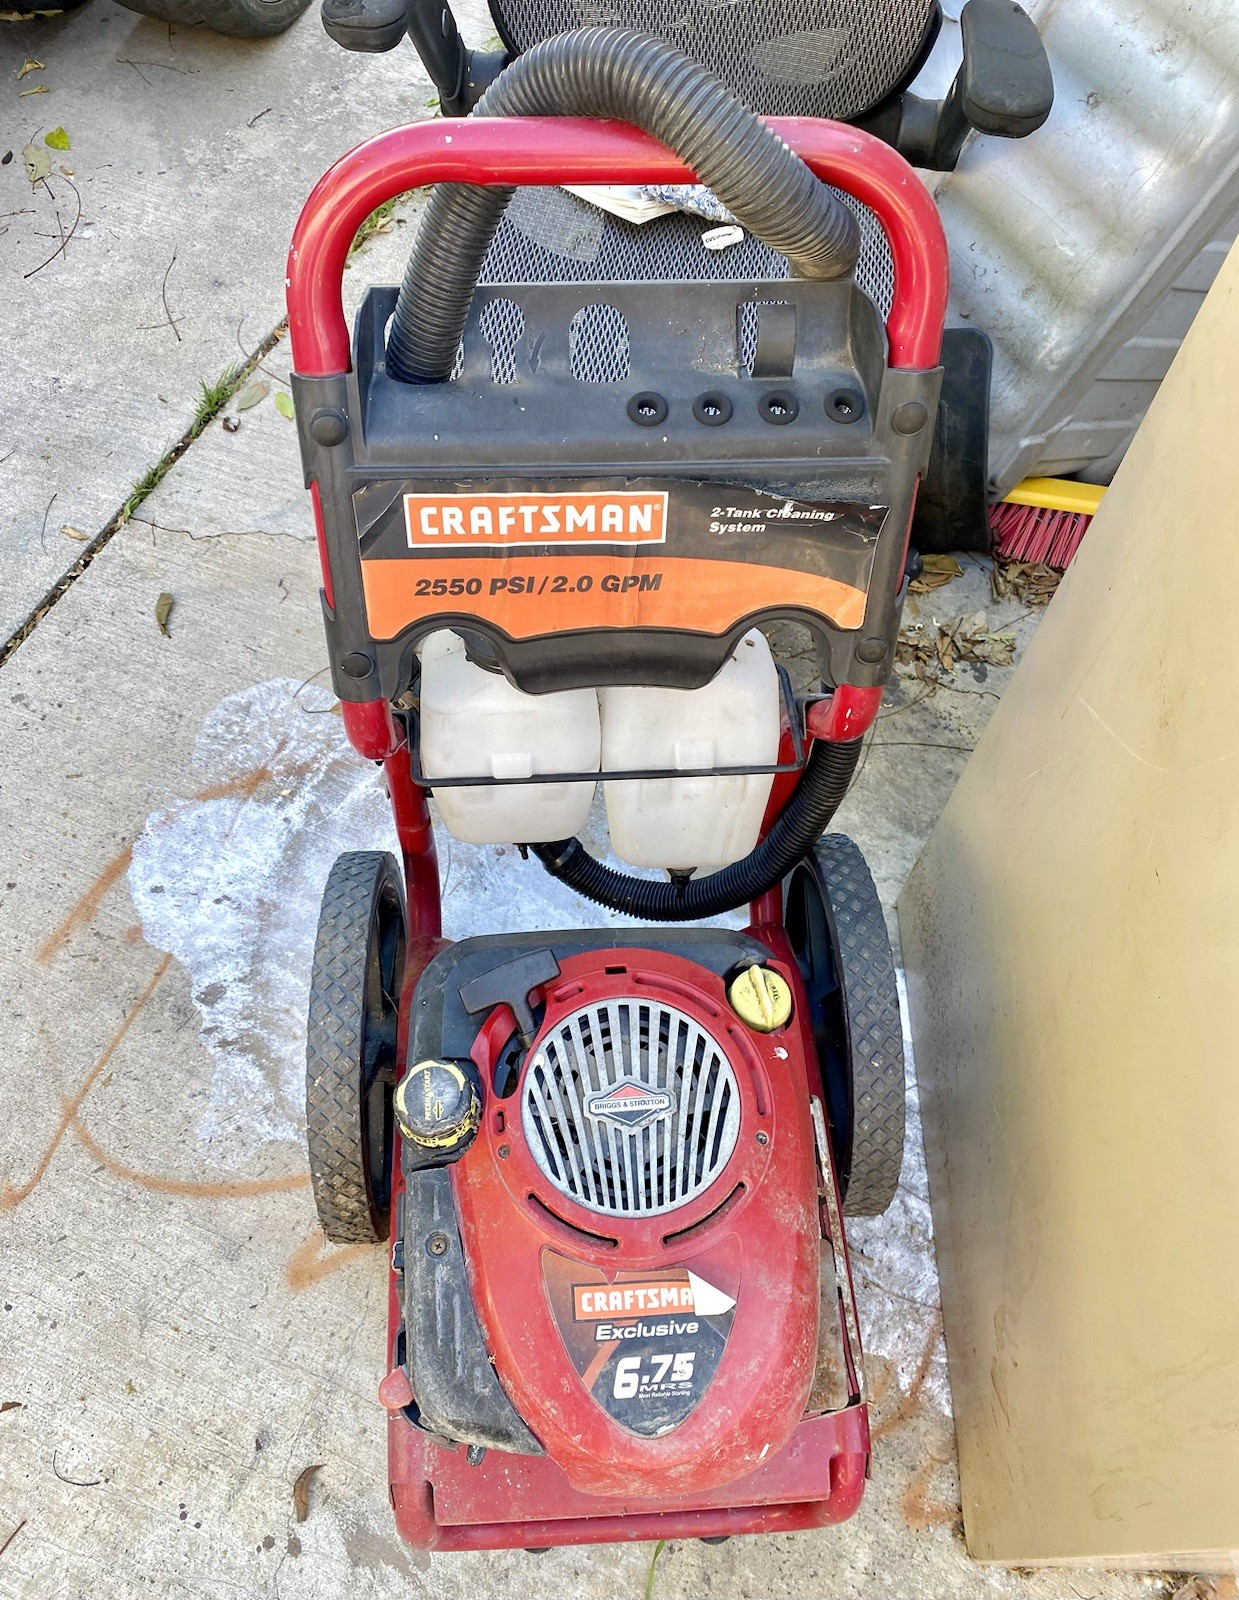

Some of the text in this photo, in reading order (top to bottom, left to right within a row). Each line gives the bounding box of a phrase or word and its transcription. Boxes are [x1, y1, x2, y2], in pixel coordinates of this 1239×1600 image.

[419, 504, 653, 535] CRAFTSMAN
[710, 507, 762, 519] 2-Tank
[709, 521, 767, 534] System
[414, 577, 483, 597] 2550
[600, 573, 664, 594] GPM
[423, 1069, 432, 1121] FRESH START
[594, 1101, 622, 1110] BRIGGS
[629, 1098, 666, 1108] STRATTON
[580, 1286, 694, 1313] CRAFTSMA
[595, 1320, 700, 1341] Exclusive
[613, 1351, 696, 1400] 6.75
[639, 1381, 693, 1393] MRS
[671, 1389, 691, 1397] Starting
